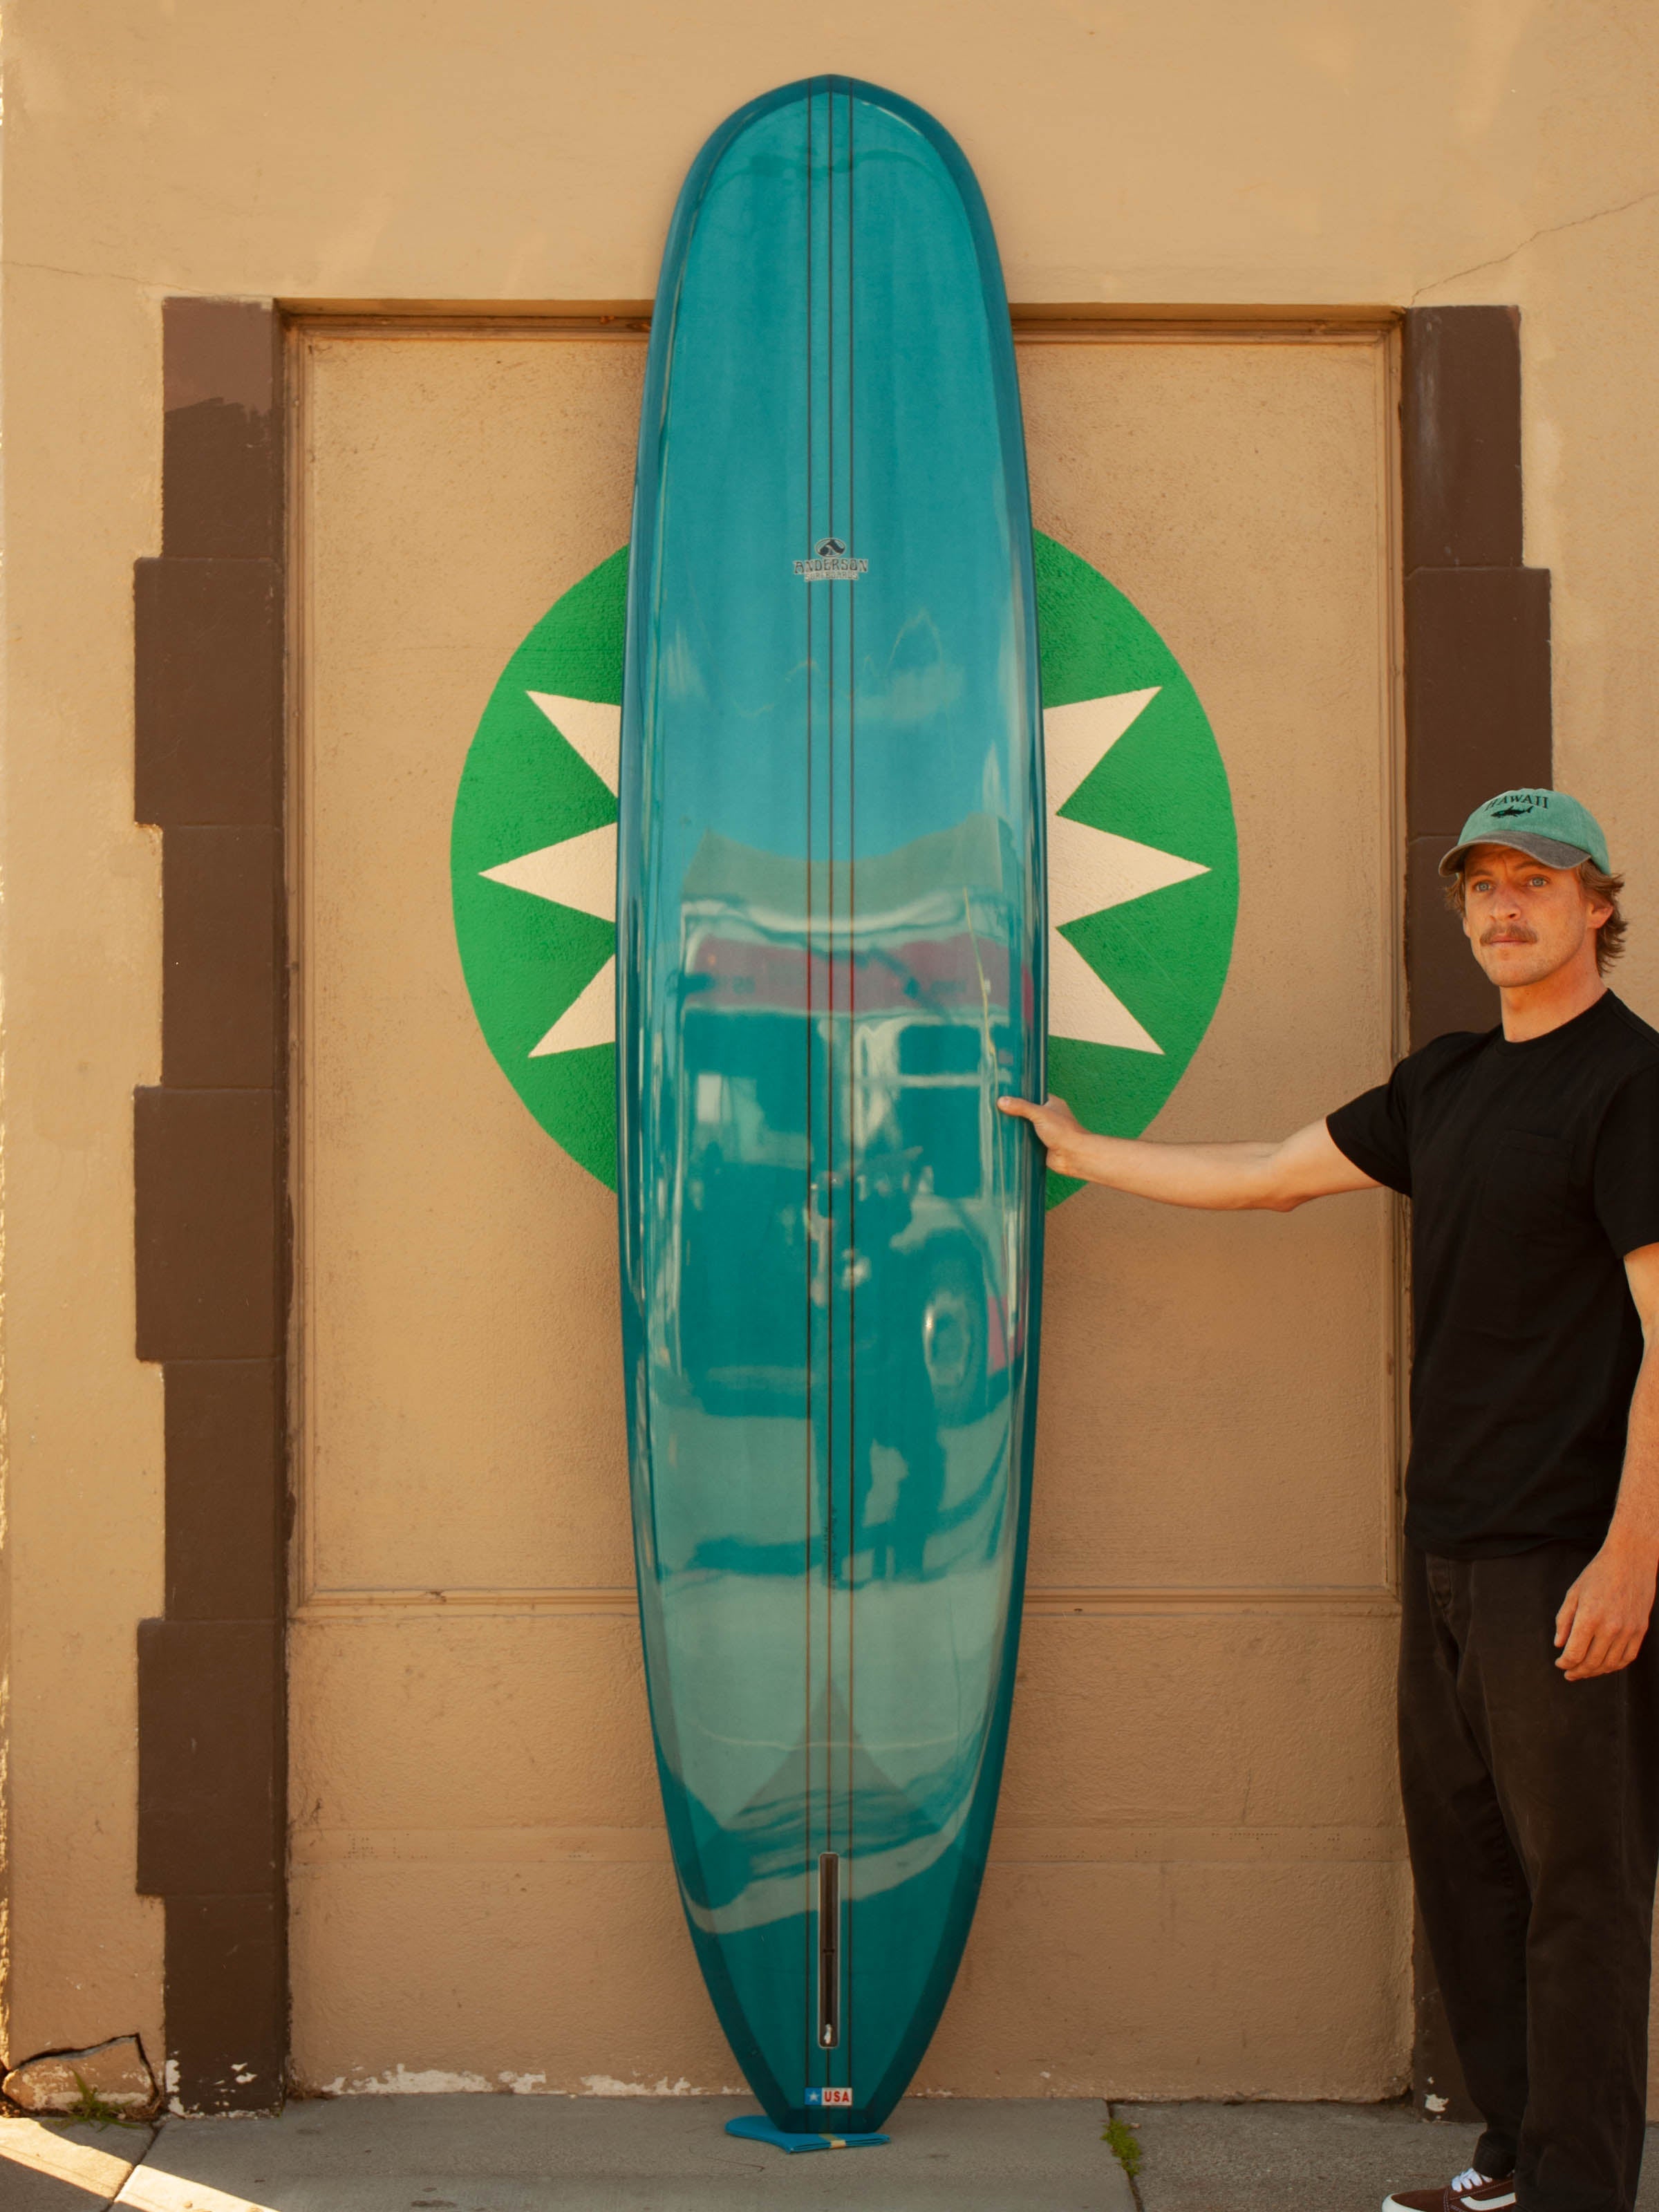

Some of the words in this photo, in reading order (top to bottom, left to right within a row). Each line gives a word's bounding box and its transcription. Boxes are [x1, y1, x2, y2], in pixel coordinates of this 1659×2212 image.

[794, 559, 868, 574] ANDERSON
[1483, 794, 1549, 812] HAWAII
[824, 2090, 850, 2103] USA
